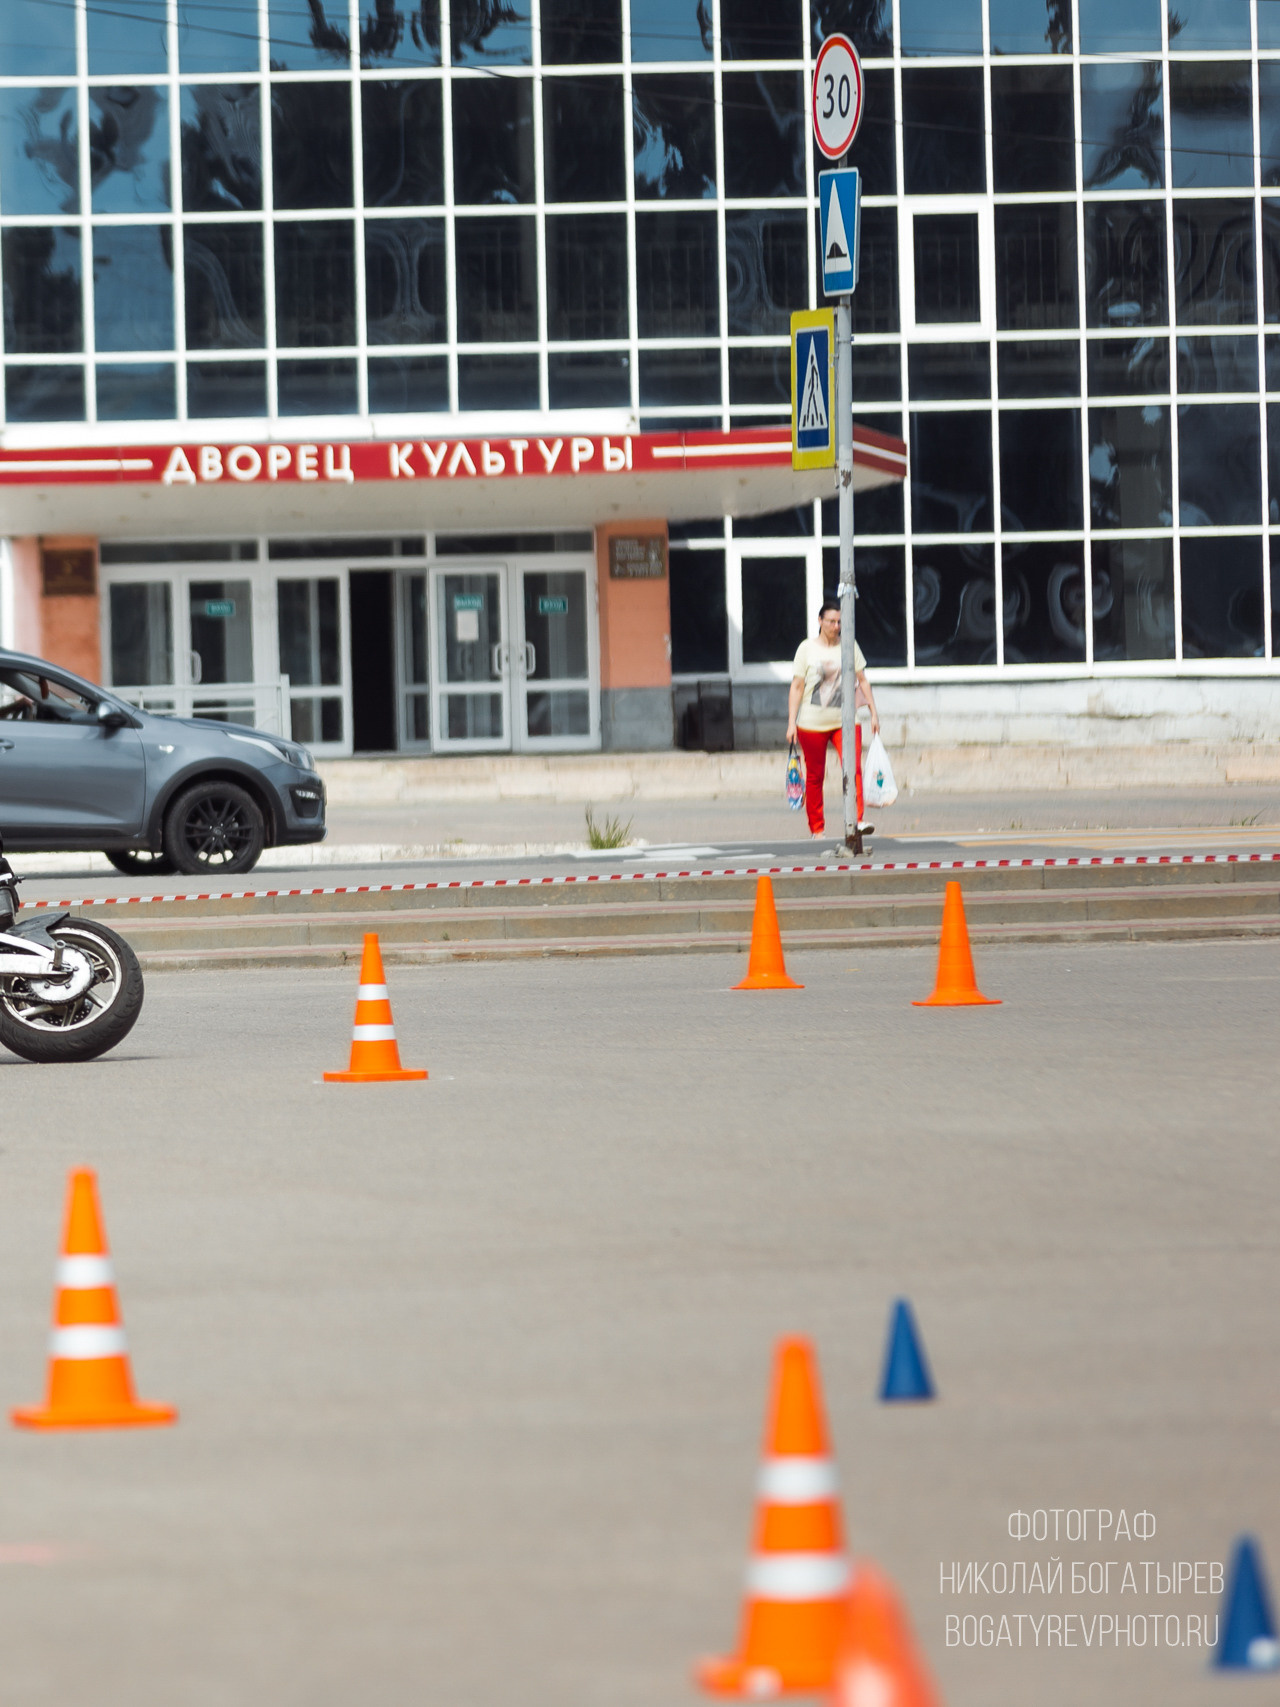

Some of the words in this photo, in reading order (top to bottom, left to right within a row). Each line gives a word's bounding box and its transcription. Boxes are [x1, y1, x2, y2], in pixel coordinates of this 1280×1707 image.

[822, 73, 851, 119] 30
[162, 444, 355, 485] ДВОРЕЦ
[389, 435, 634, 478] КУЛЬТУРЫ
